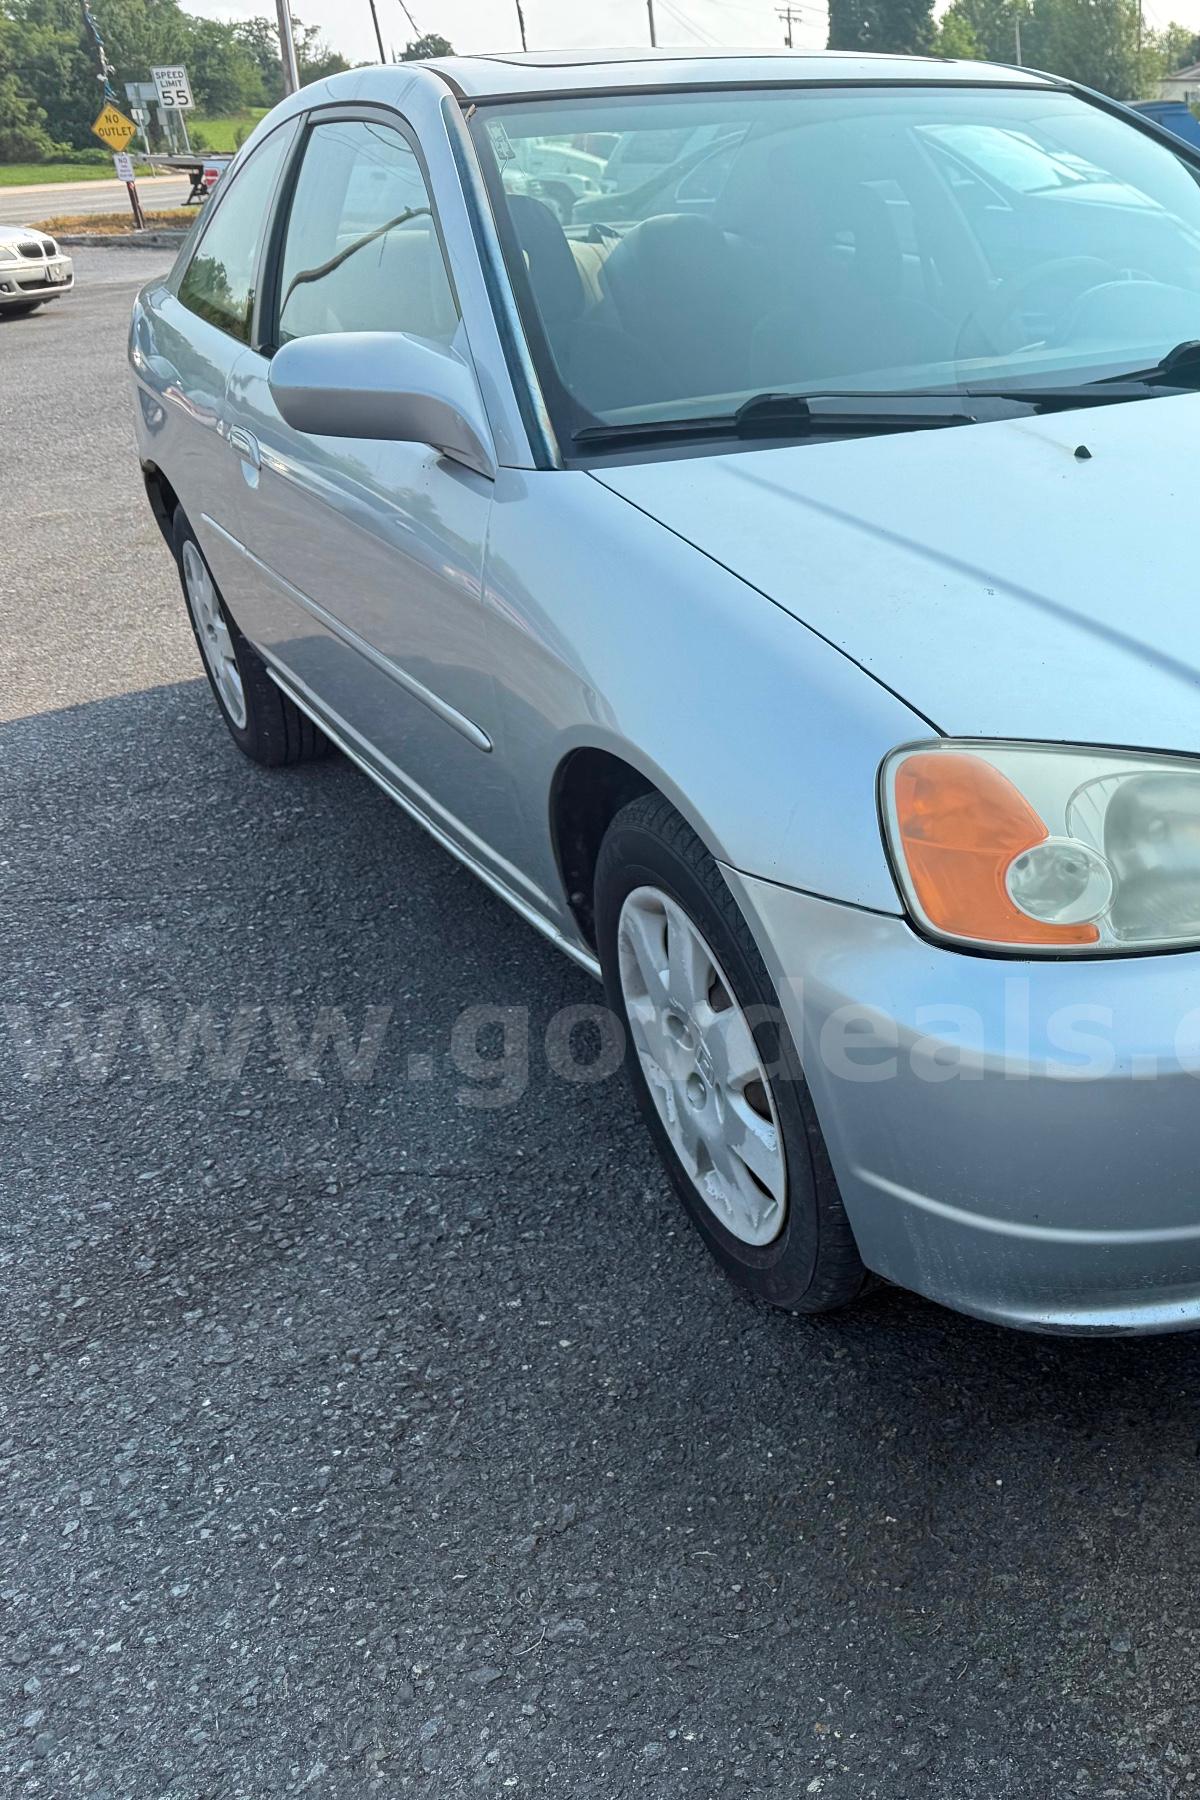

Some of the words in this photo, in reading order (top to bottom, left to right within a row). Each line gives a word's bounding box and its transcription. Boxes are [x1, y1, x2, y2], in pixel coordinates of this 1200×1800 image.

[155, 71, 184, 79] SPEED
[160, 80, 182, 88] LIMIT
[162, 90, 189, 106] 55
[104, 114, 119, 124] NO
[98, 126, 132, 137] OUTLET
